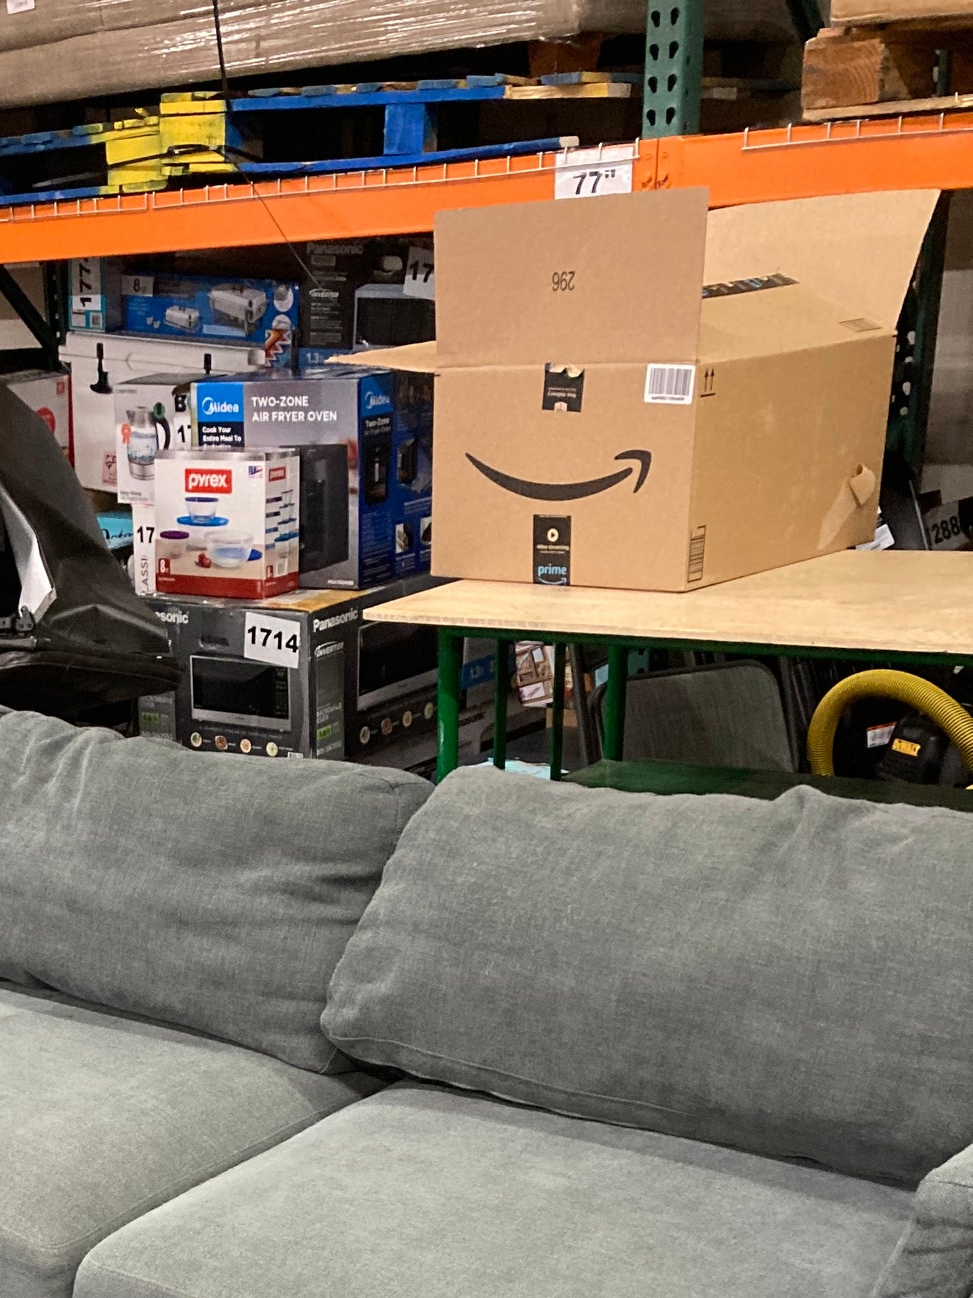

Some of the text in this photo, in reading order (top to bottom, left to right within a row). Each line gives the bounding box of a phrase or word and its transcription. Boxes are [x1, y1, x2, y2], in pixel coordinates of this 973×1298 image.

[573, 169, 616, 195] 77"
[551, 270, 576, 292] 296
[201, 396, 240, 416] Midea
[251, 396, 309, 408] TWO-ZONE
[251, 410, 338, 423] AIR FRYER OVEN
[202, 434, 220, 442] Entire
[233, 434, 242, 442] To
[188, 473, 228, 489] pyrex
[537, 563, 567, 576] prime
[313, 607, 358, 633] Panasonic
[246, 625, 299, 654] 1714
